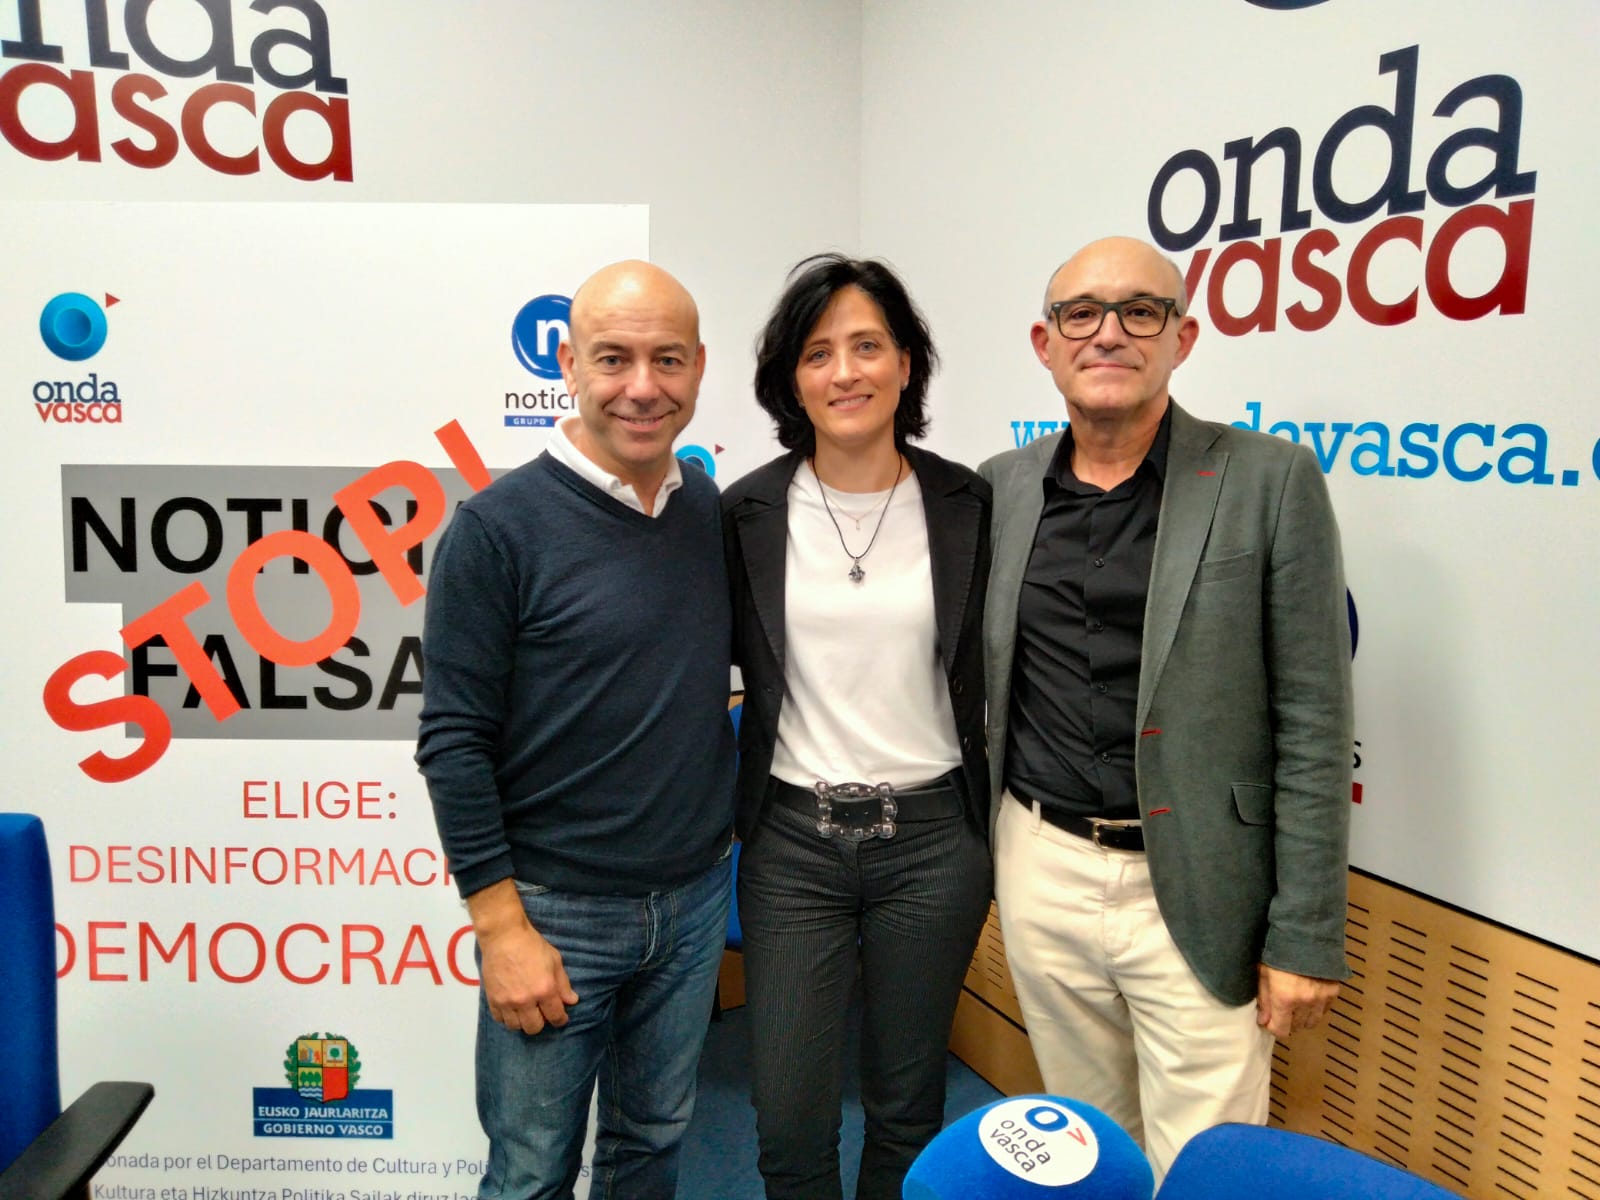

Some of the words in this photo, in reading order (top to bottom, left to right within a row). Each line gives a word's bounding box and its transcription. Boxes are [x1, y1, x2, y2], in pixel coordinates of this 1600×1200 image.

[0, 63, 354, 183] asca
[1147, 44, 1537, 252] onda
[33, 373, 121, 403] onda
[35, 402, 122, 423] vasca
[71, 497, 464, 575] NOTICI
[244, 781, 397, 820] ELIGE:
[69, 845, 450, 886] DESINFORMACI
[258, 1106, 300, 1117] EUSKO
[304, 1107, 388, 1119] JAURLARITZA
[263, 1123, 335, 1134] GOBIERNO
[338, 1124, 384, 1136] VASCO
[990, 1128, 1036, 1172] vasca
[1000, 1119, 1051, 1165] onda
[164, 1156, 192, 1171] por
[197, 1155, 211, 1169] el
[217, 1154, 343, 1173] Departamento
[347, 1157, 367, 1173] de
[372, 1157, 437, 1175] Cultura
[442, 1162, 451, 1177] y
[94, 1183, 155, 1200] Kultura
[160, 1186, 187, 1200] eta
[193, 1186, 276, 1200] Hizkuntza
[282, 1188, 345, 1200] Politika
[350, 1189, 402, 1200] Sailak
